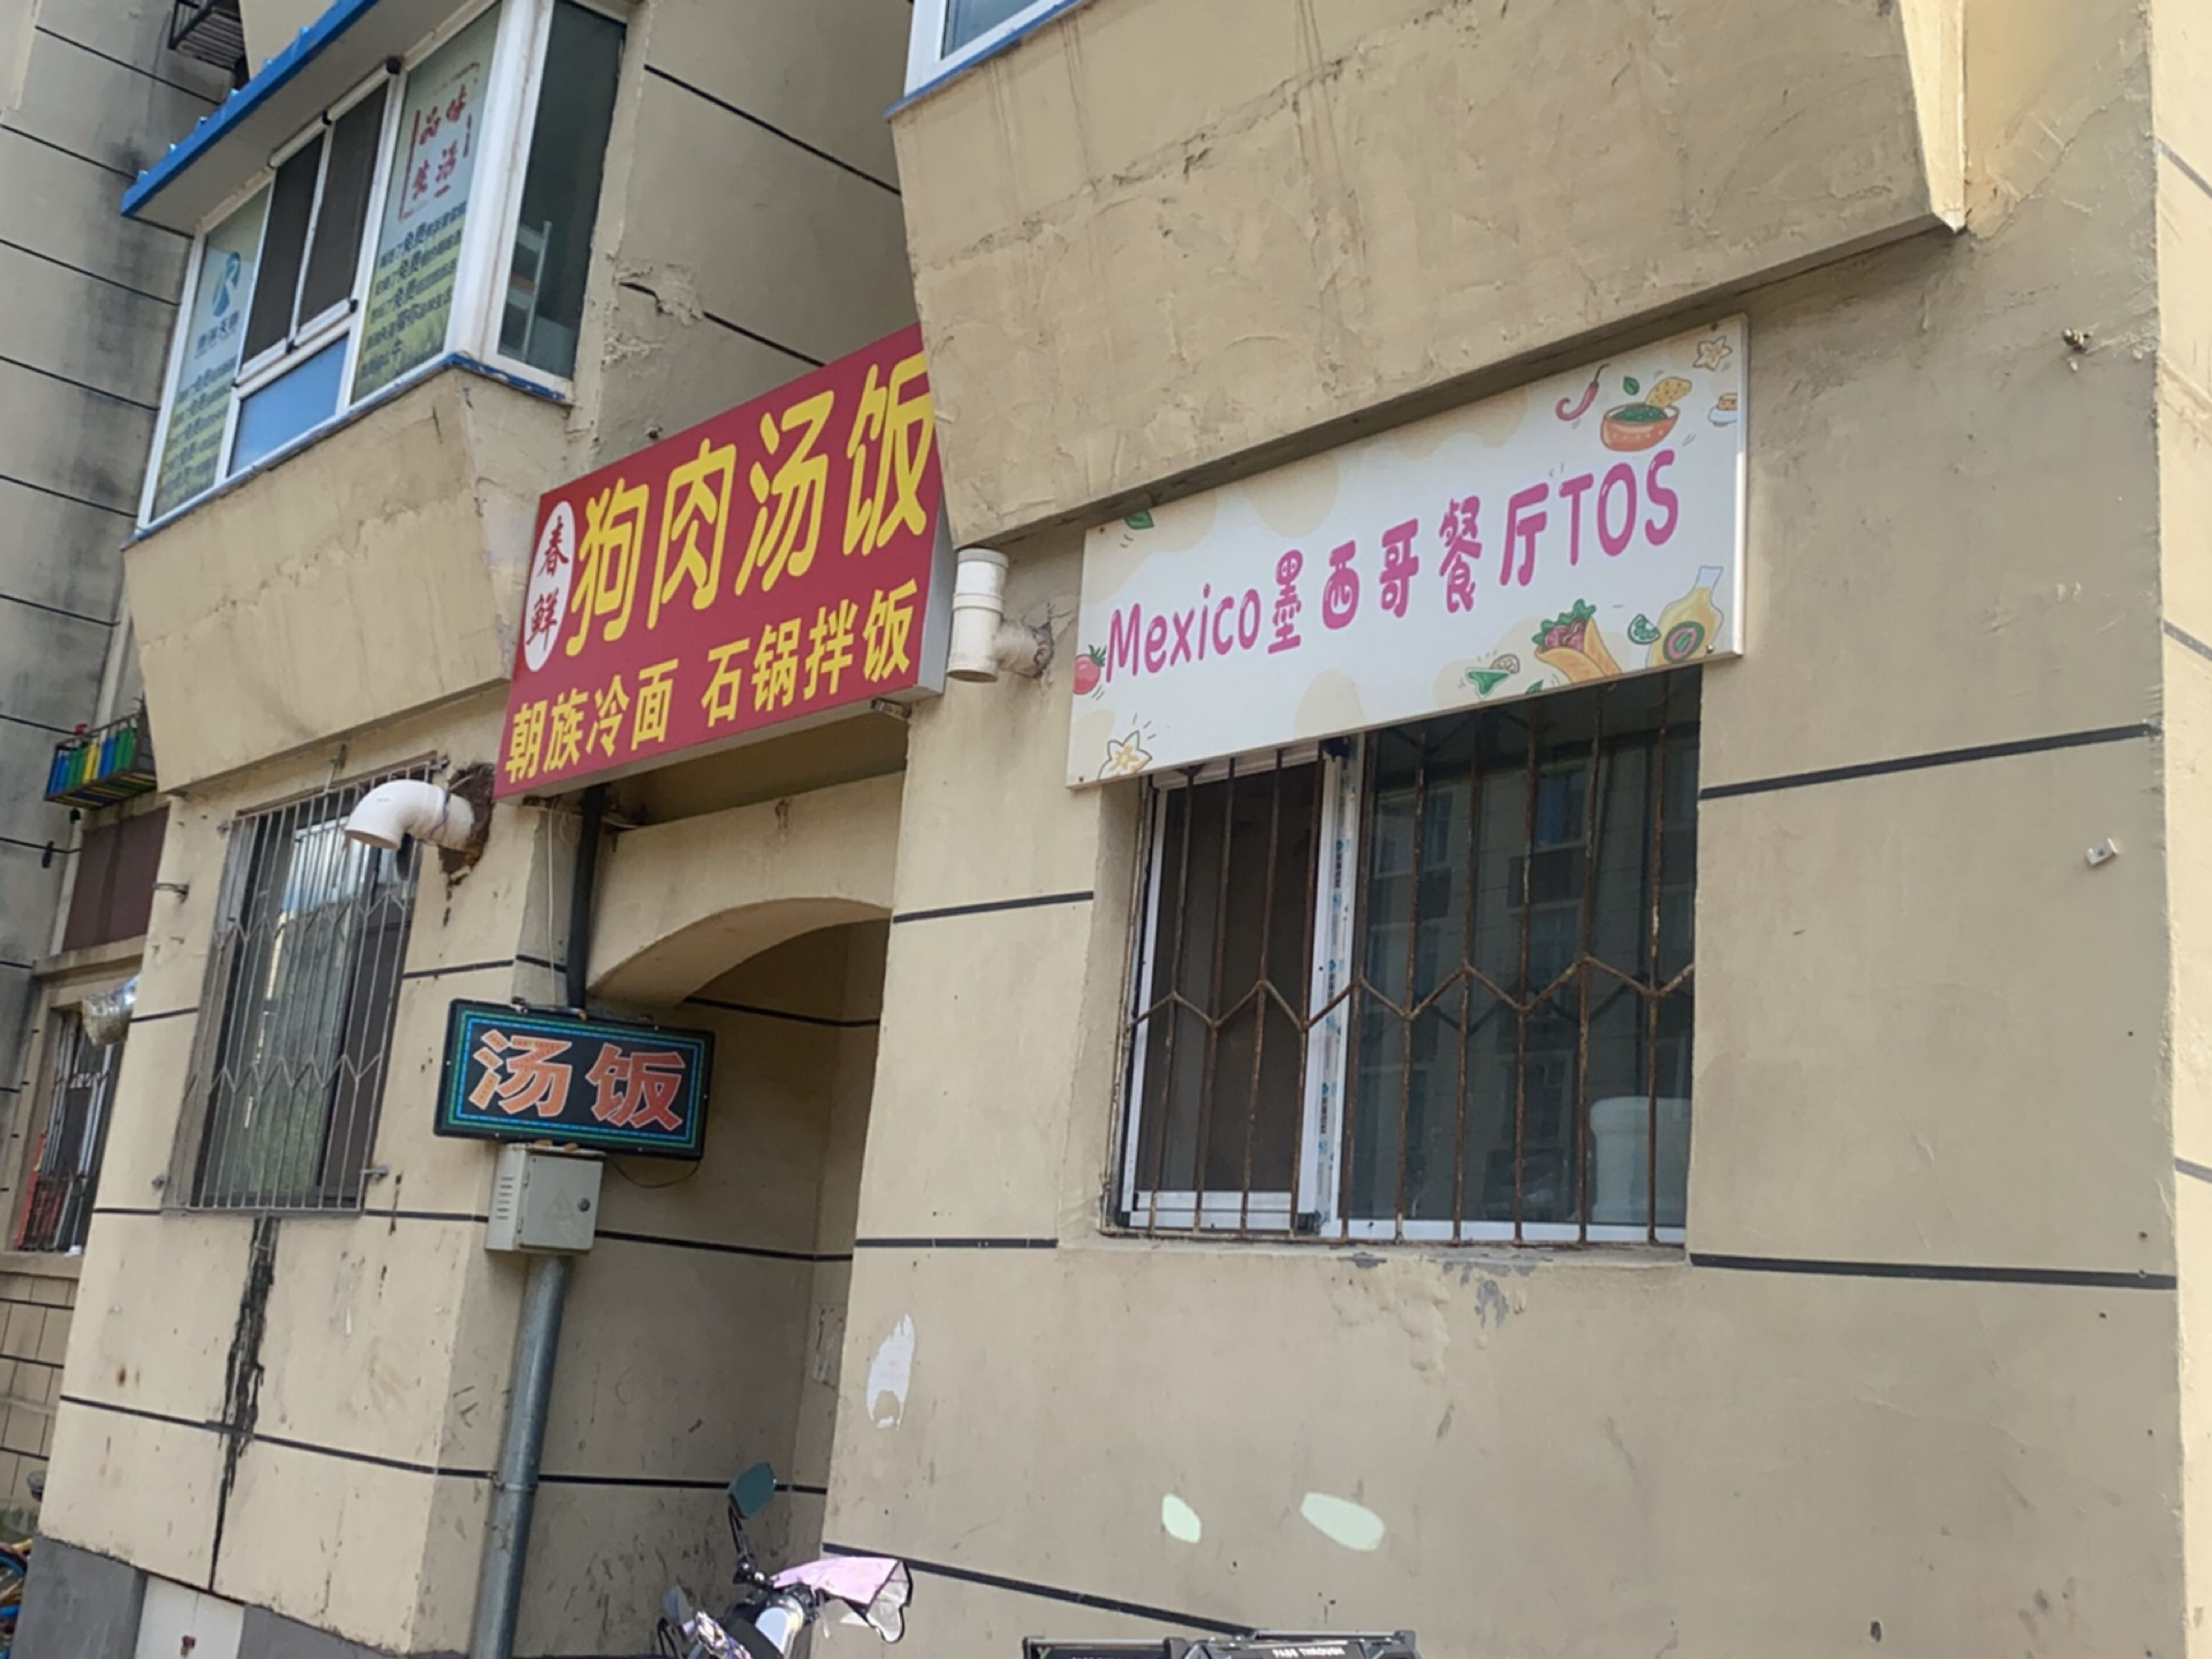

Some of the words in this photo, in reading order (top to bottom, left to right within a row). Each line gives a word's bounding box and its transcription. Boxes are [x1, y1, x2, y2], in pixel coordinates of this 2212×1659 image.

[566, 351, 935, 656] 狗肉汤饭
[505, 659, 678, 783] 朝族冷面
[701, 579, 918, 728] 石锅拌饭
[469, 1029, 685, 1132] 汤饭
